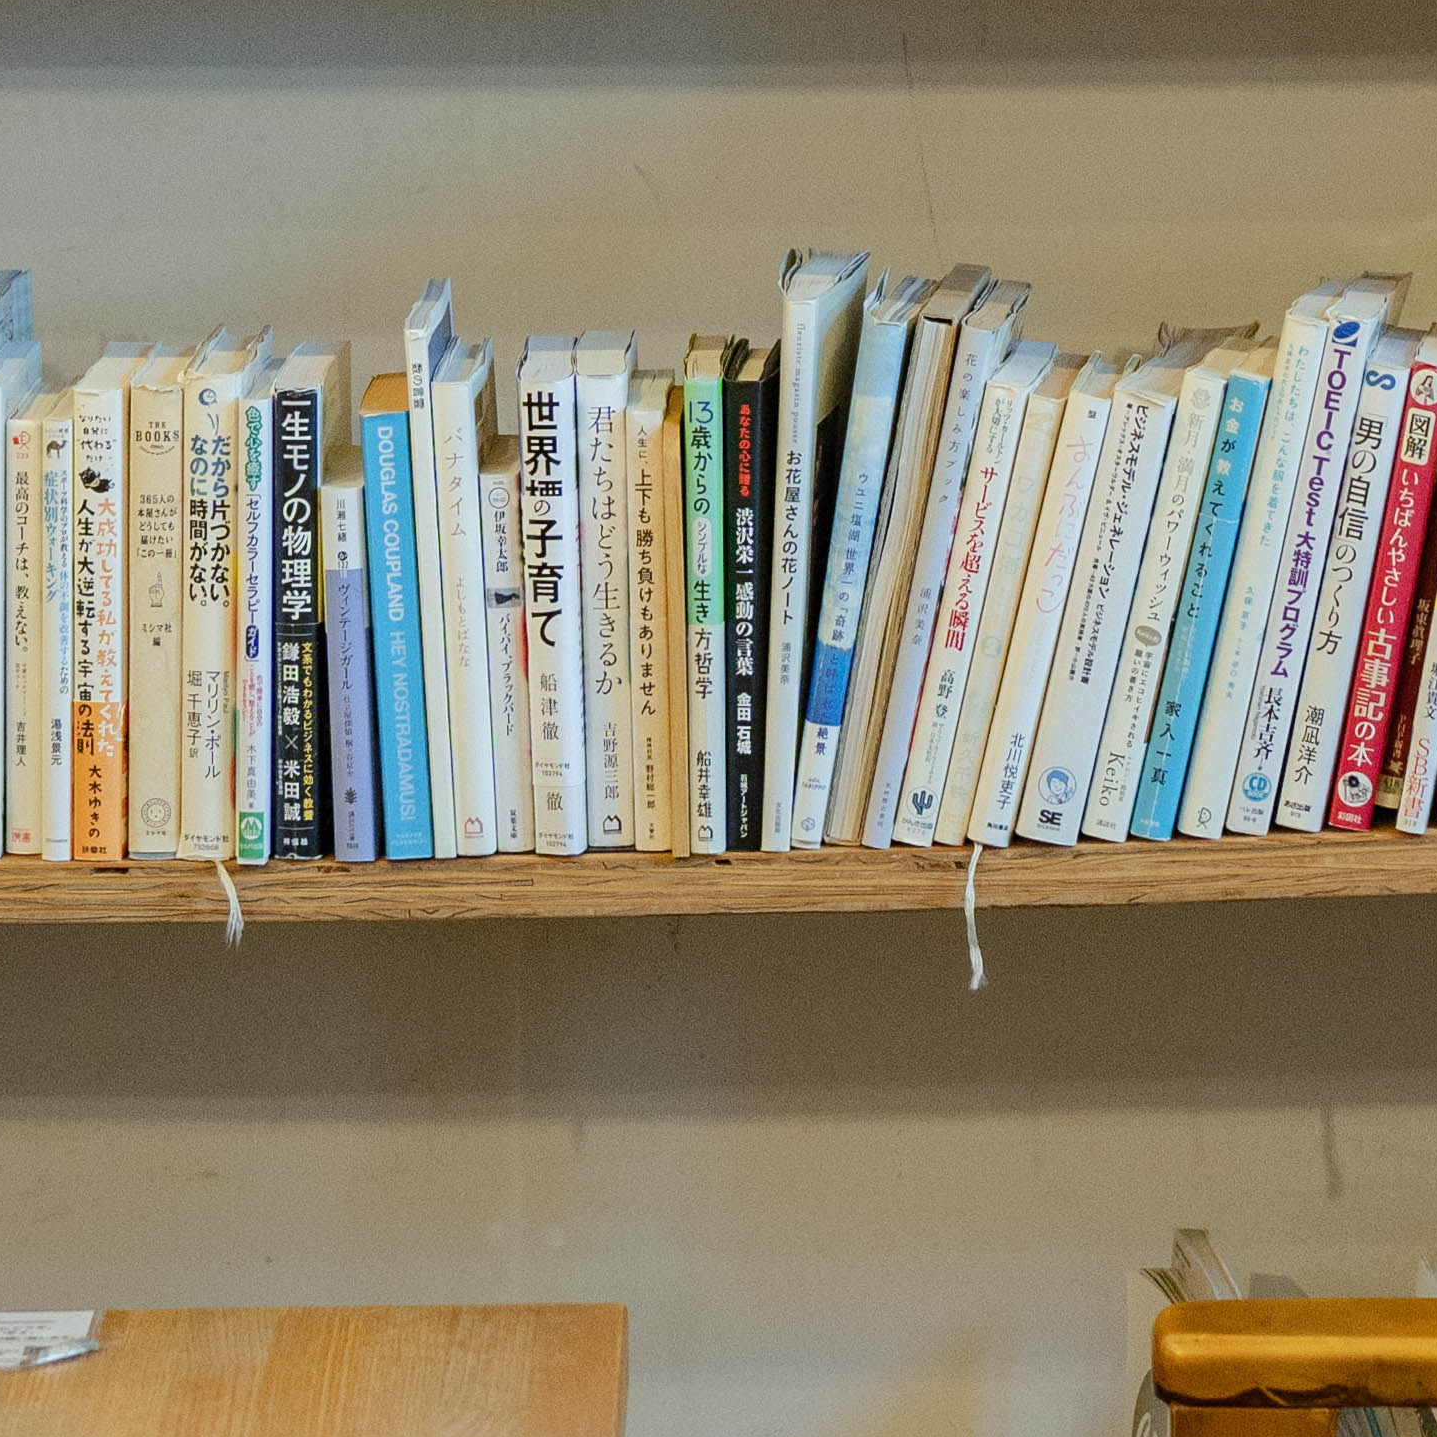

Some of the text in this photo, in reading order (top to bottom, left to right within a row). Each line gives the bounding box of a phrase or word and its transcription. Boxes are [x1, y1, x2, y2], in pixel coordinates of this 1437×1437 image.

[135, 427, 179, 442] BOOKS
[376, 426, 394, 511] DOUGLAS
[188, 434, 209, 606] なのに時間がない。
[209, 434, 232, 608] だから片づかない。
[380, 516, 405, 622] COUPLAND
[586, 405, 623, 697] 君たちはどう生きるか
[780, 450, 801, 626] お花屋さんの花ノート
[943, 465, 999, 652] サービスを超える瞬間
[1269, 346, 1353, 679] TOEIC Test 大特訓プログラム
[389, 631, 407, 669] HEY
[602, 721, 621, 800] 吉野源三郎
[1098, 753, 1126, 807] Keiko
